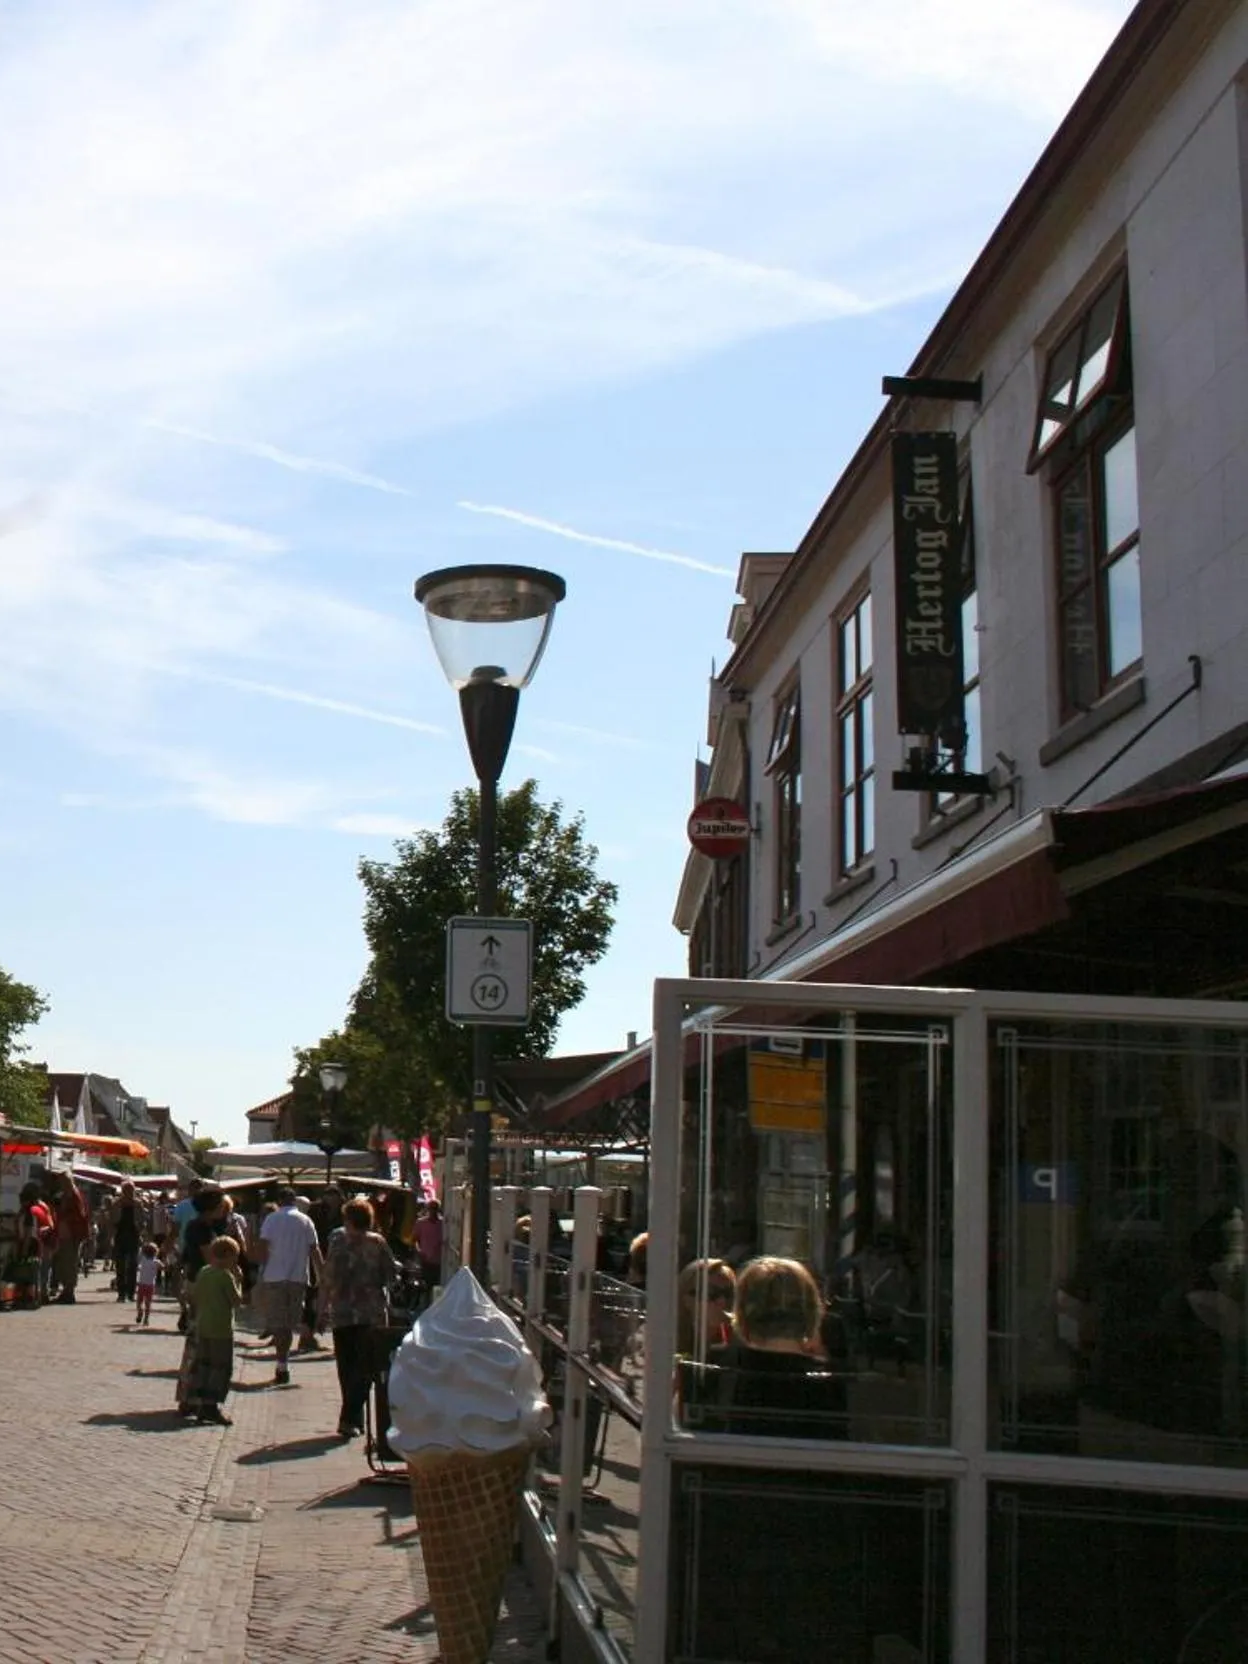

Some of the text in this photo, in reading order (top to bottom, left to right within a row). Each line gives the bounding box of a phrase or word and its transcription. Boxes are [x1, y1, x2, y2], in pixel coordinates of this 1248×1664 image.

[903, 454, 955, 657] Hertog Jan
[478, 983, 500, 1002] 14
